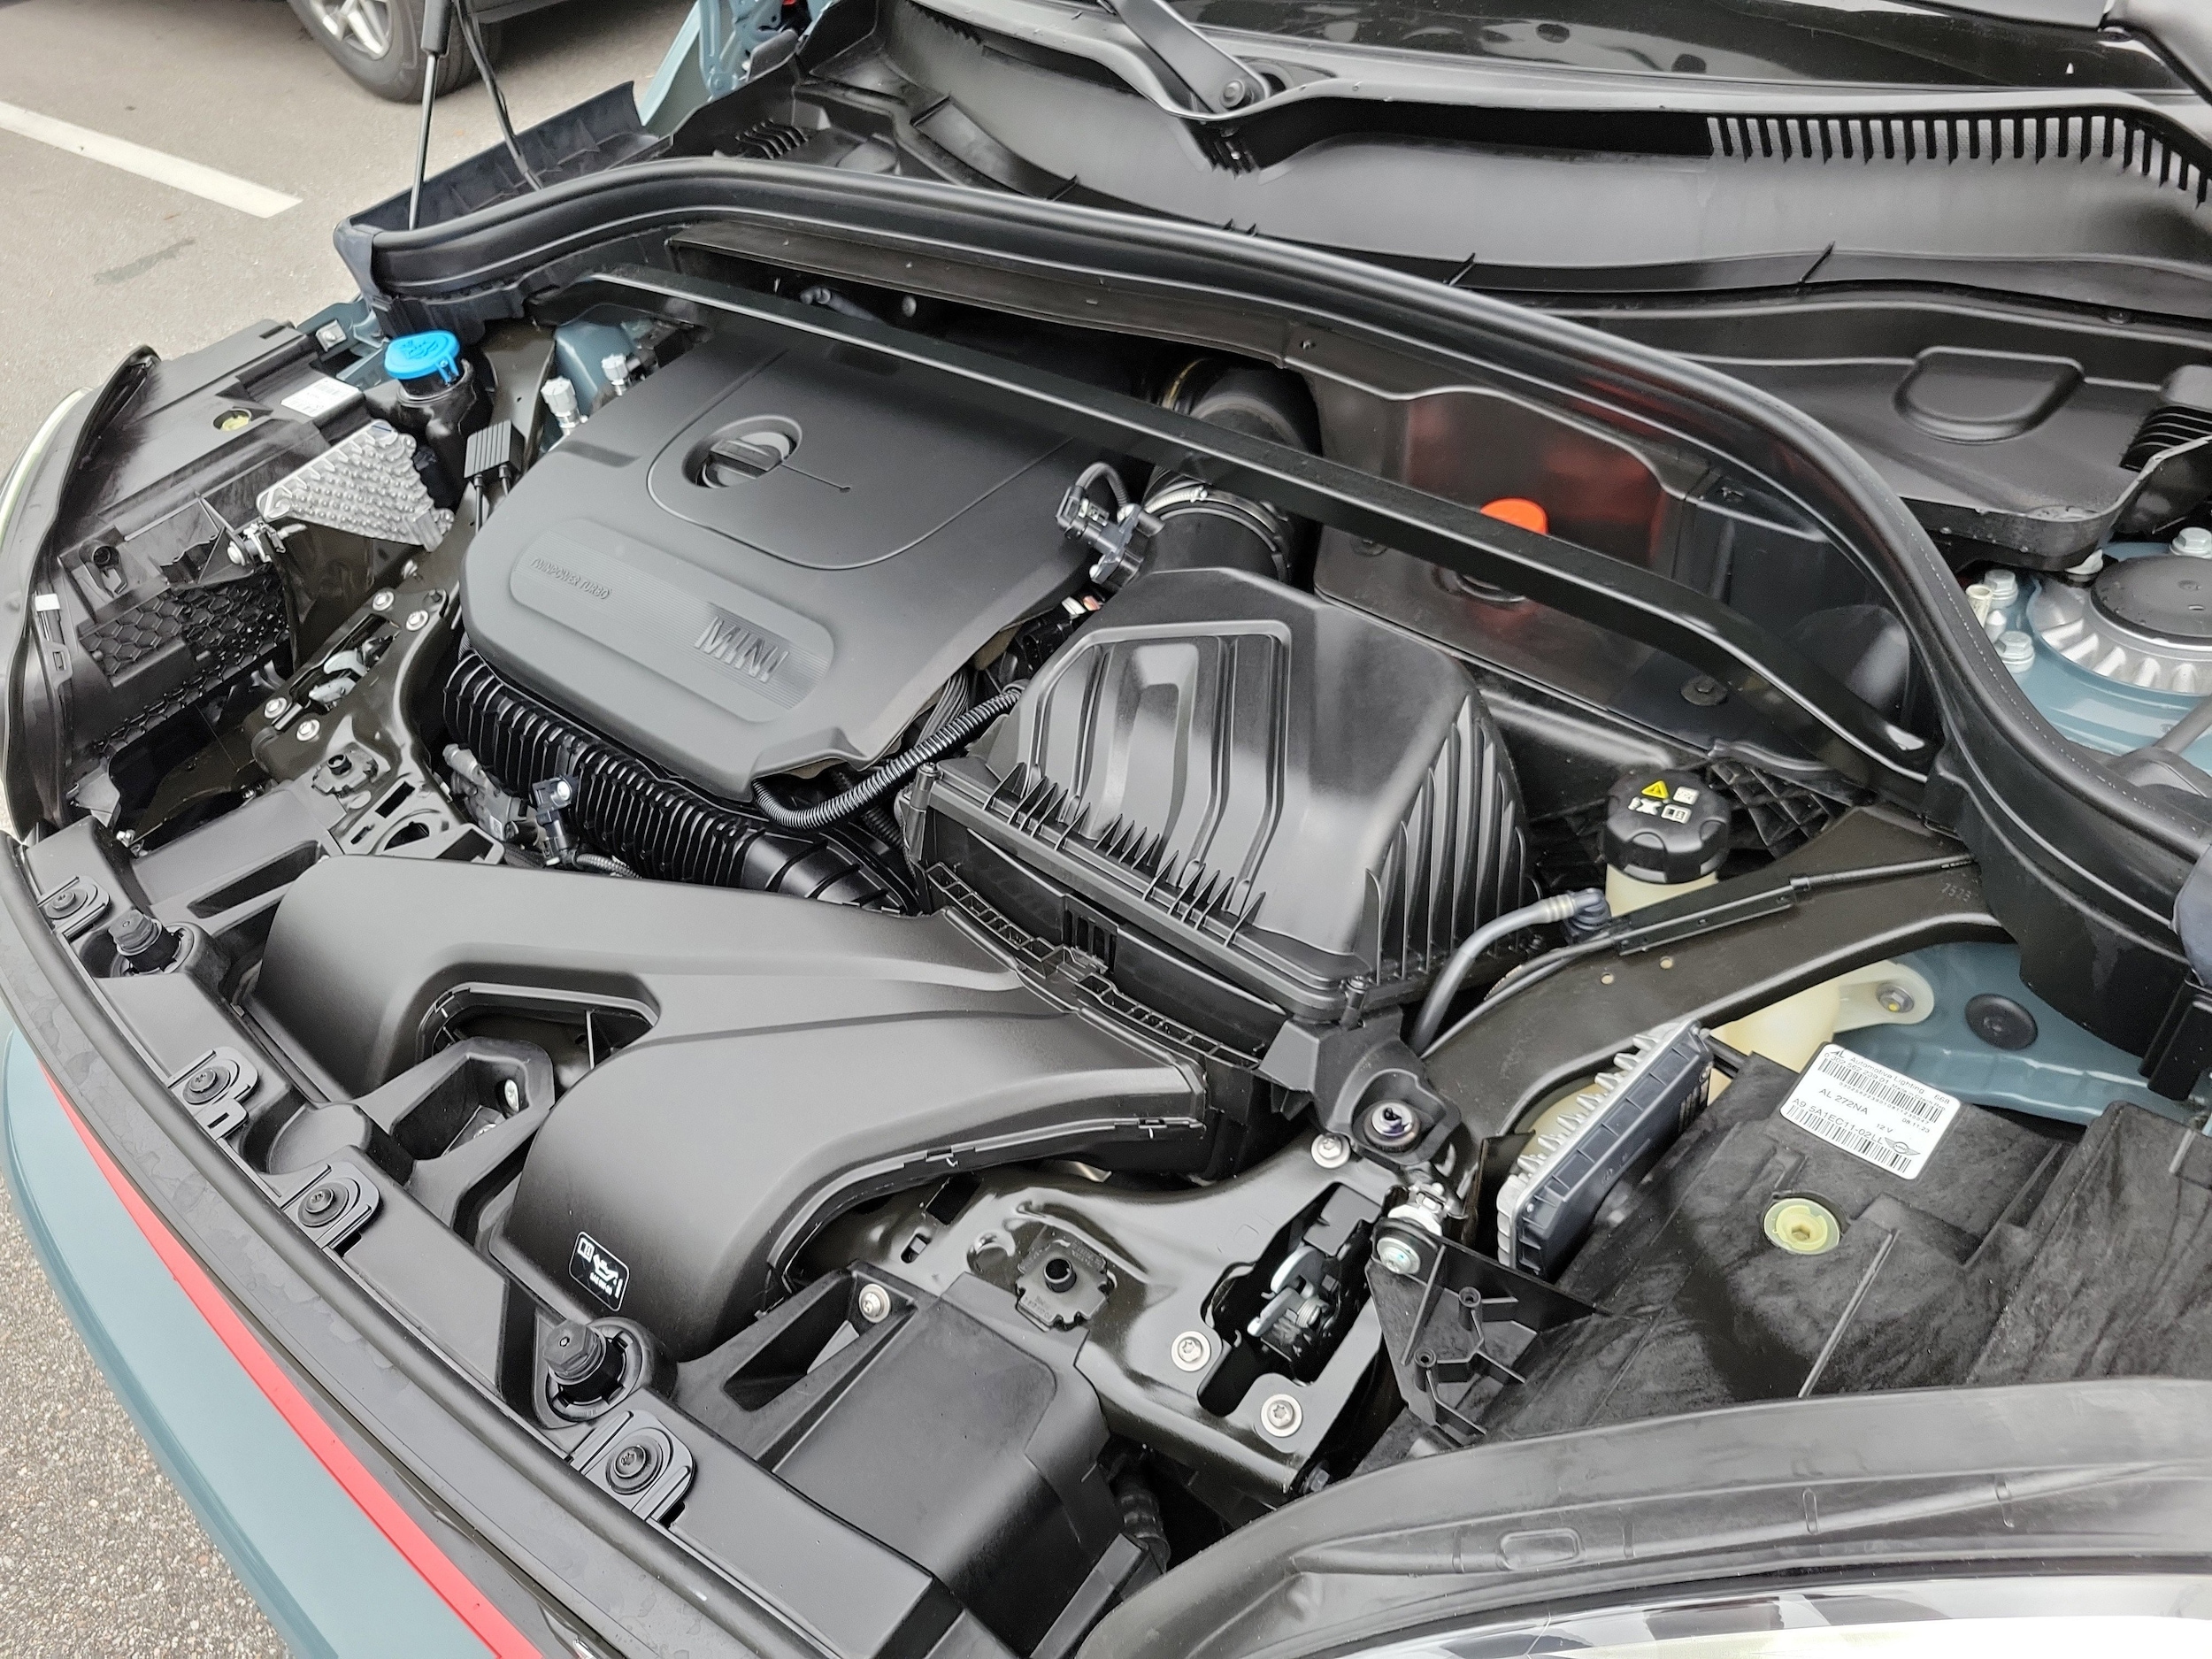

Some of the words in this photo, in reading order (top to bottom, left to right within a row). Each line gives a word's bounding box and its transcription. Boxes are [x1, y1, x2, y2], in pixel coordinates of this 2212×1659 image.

[530, 557, 580, 587] TWINPOWER
[580, 577, 611, 600] TURBO
[695, 615, 789, 684] MINI
[1847, 1063, 1863, 1071] 562
[1863, 1070, 1878, 1079] 239
[1850, 1057, 1893, 1079] Automotive
[1893, 1076, 1924, 1094] Lighting
[1792, 1098, 1807, 1108] A9
[1818, 1088, 1832, 1099] AL
[1834, 1094, 1868, 1115] 272NA
